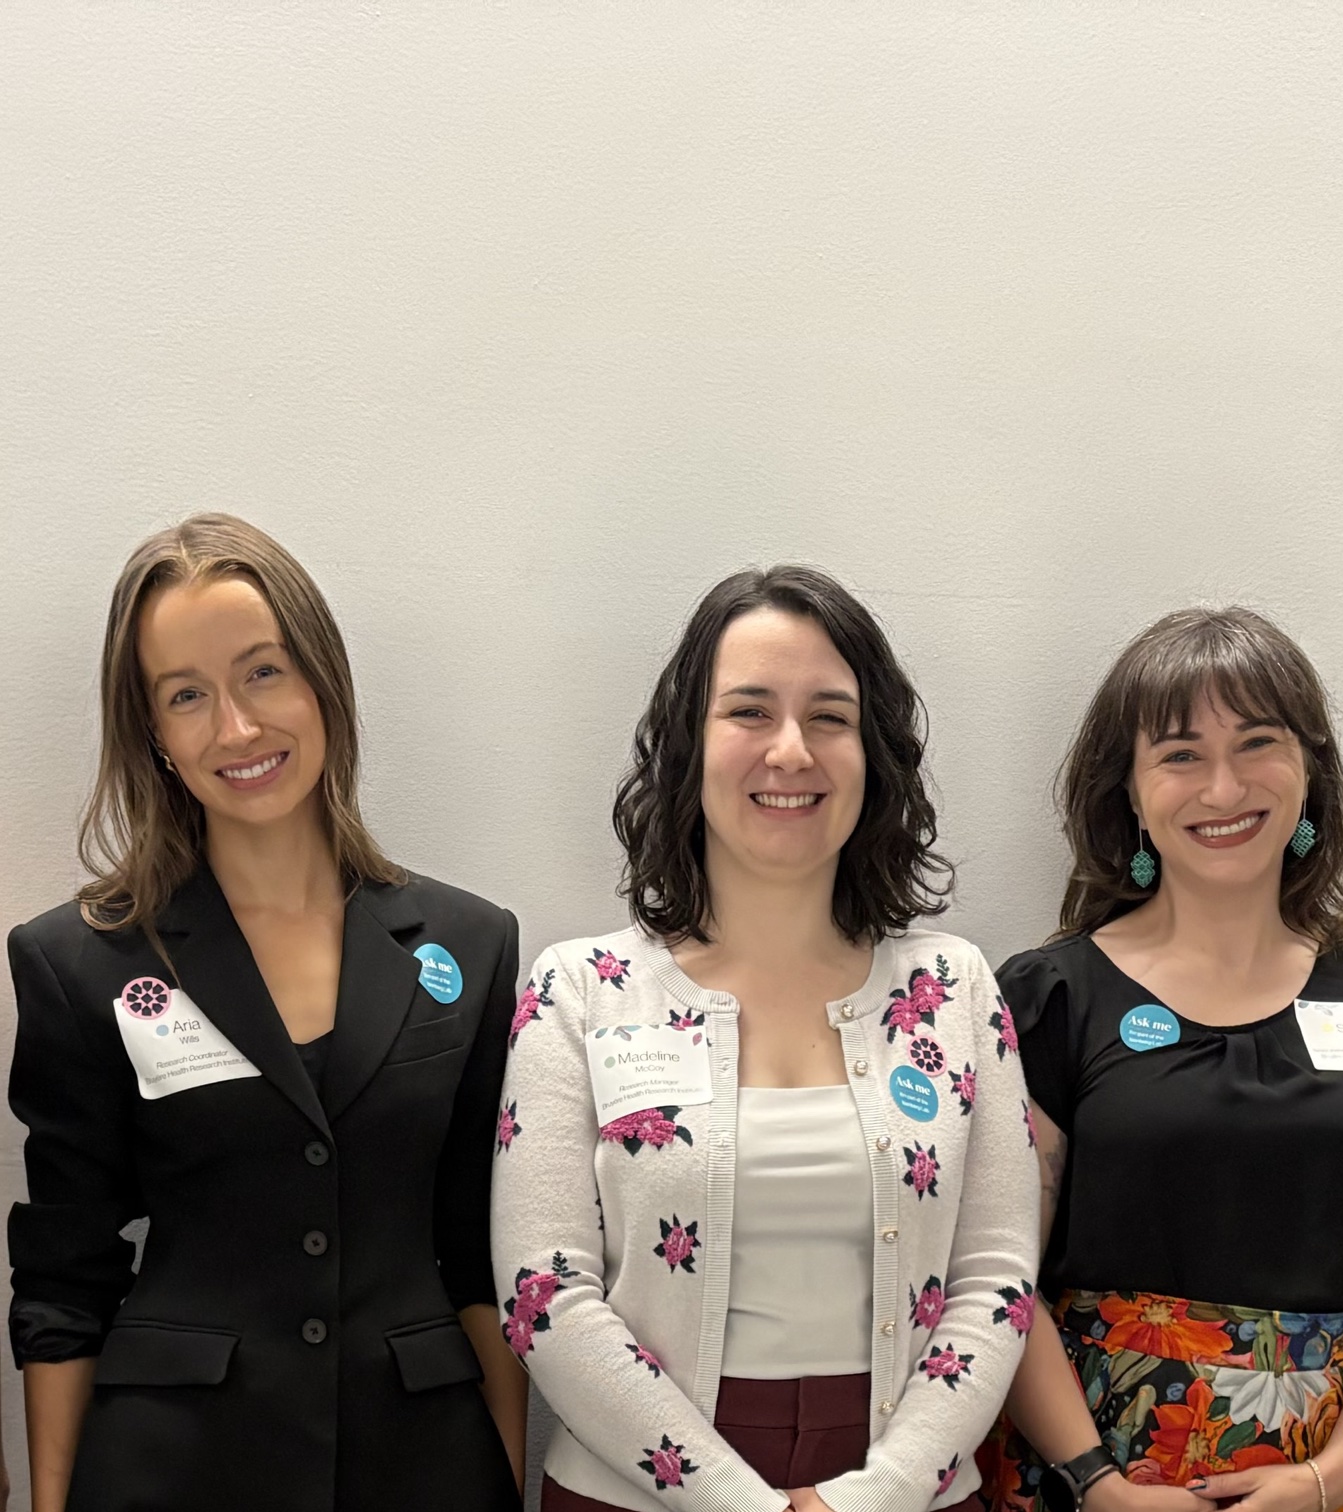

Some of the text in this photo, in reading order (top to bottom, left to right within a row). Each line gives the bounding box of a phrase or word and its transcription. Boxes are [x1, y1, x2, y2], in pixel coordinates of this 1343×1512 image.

[422, 957, 453, 974] sk me
[173, 1018, 201, 1034] Aria
[1127, 1015, 1172, 1032] Ask me
[179, 1035, 200, 1046] Wills
[156, 1049, 229, 1070] Research Coordinator
[617, 1050, 681, 1065] Madeline
[635, 1064, 666, 1073] McCoy
[619, 1080, 649, 1092] Research
[896, 1075, 931, 1096] Ask me
